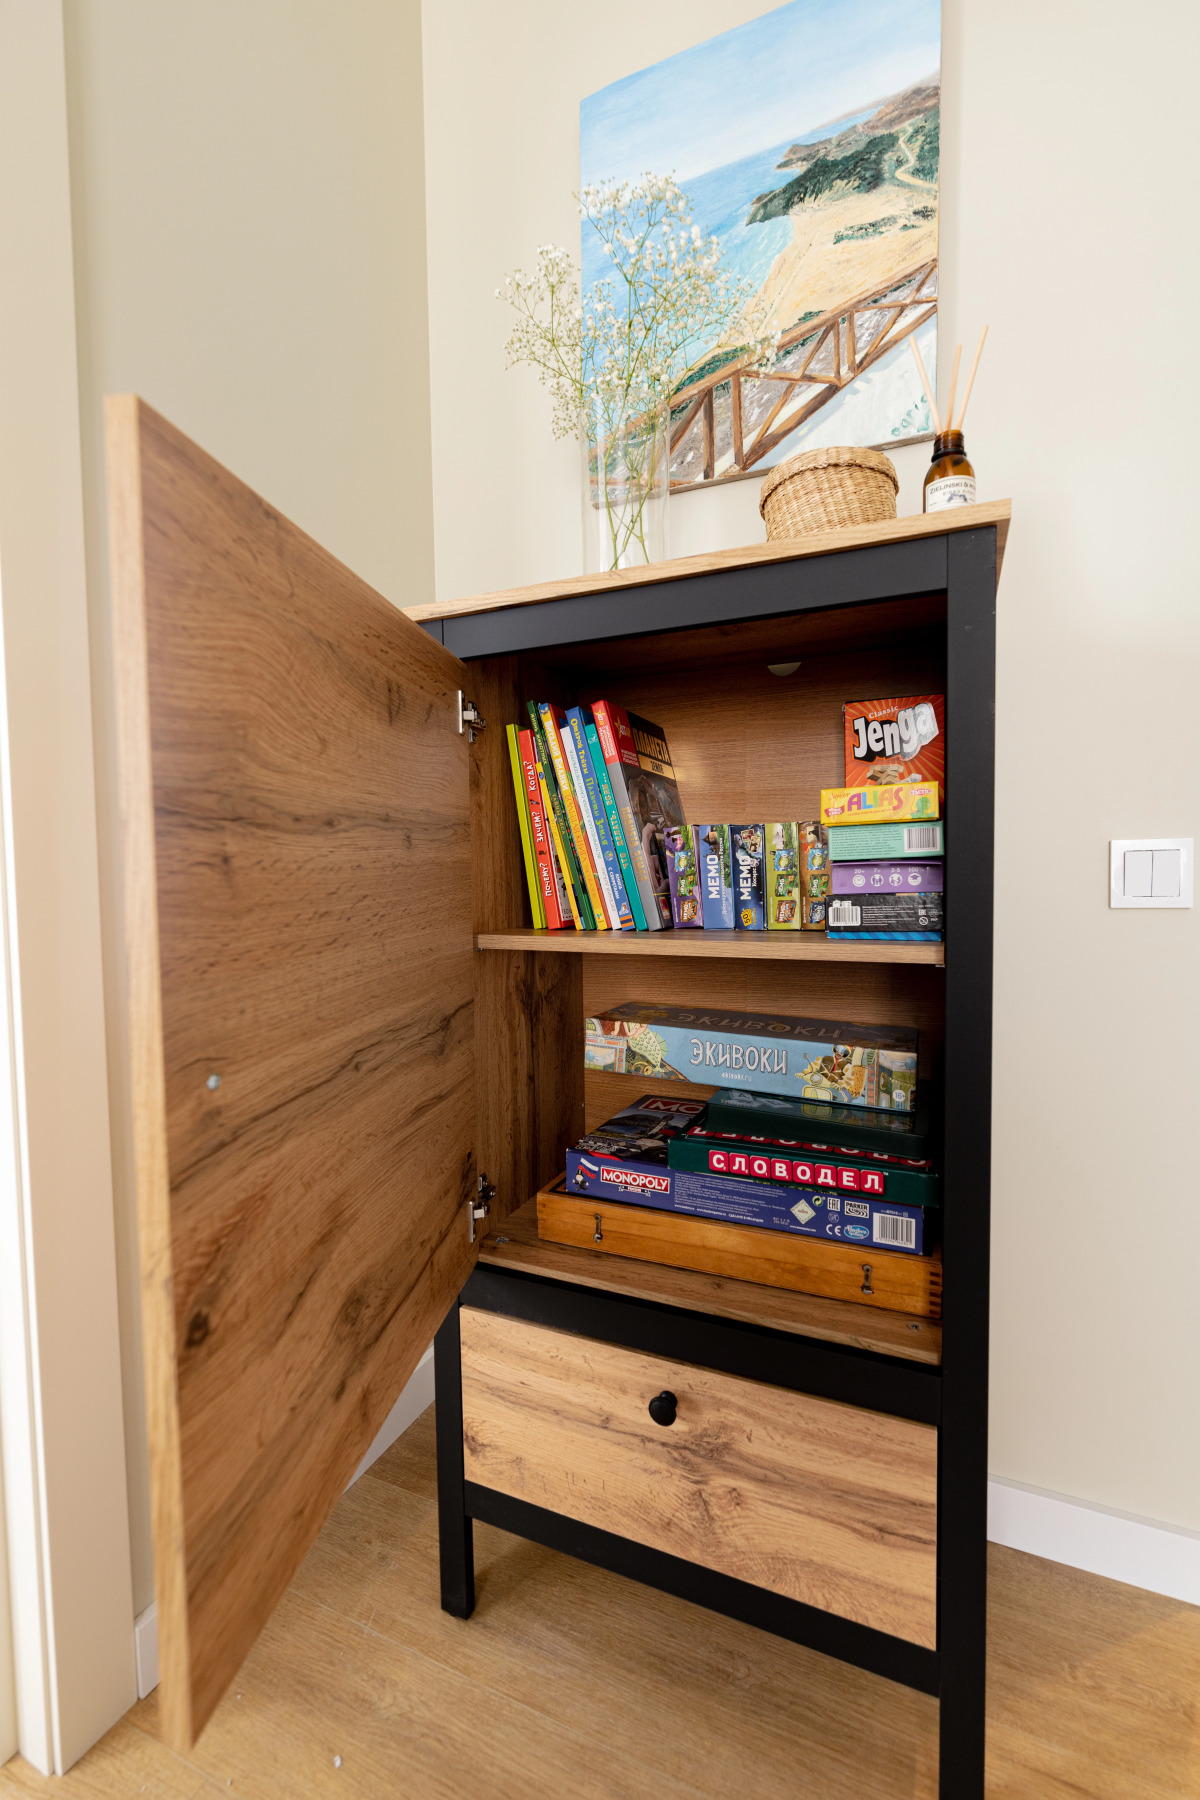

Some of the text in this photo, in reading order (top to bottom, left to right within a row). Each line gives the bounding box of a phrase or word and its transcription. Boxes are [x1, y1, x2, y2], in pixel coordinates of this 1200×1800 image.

[929, 481, 963, 495] ZIELINSKI
[868, 705, 899, 719] Classic
[853, 703, 937, 758] Jenga
[545, 720, 569, 791] ВИТАЛИЙ БИАНКИ
[632, 727, 672, 764] ПЛАНЕТА
[847, 787, 903, 811] ALIAS
[610, 810, 624, 846] ДЕЛАТЬ,
[575, 834, 587, 863] КНИГА
[621, 807, 647, 882] ПЛАНЕТА ЗЕМЛЯ
[619, 852, 629, 869] ЧТО
[743, 913, 751, 924] 50
[670, 1013, 842, 1039] ЭКИВОКИ
[689, 1038, 788, 1075] ЭКИВОКИ
[894, 1091, 906, 1100] 16+
[602, 1168, 669, 1191] MONOPOLY
[711, 1153, 880, 1191] СЛОВОДЕЛ
[845, 1201, 868, 1211] PARKER
